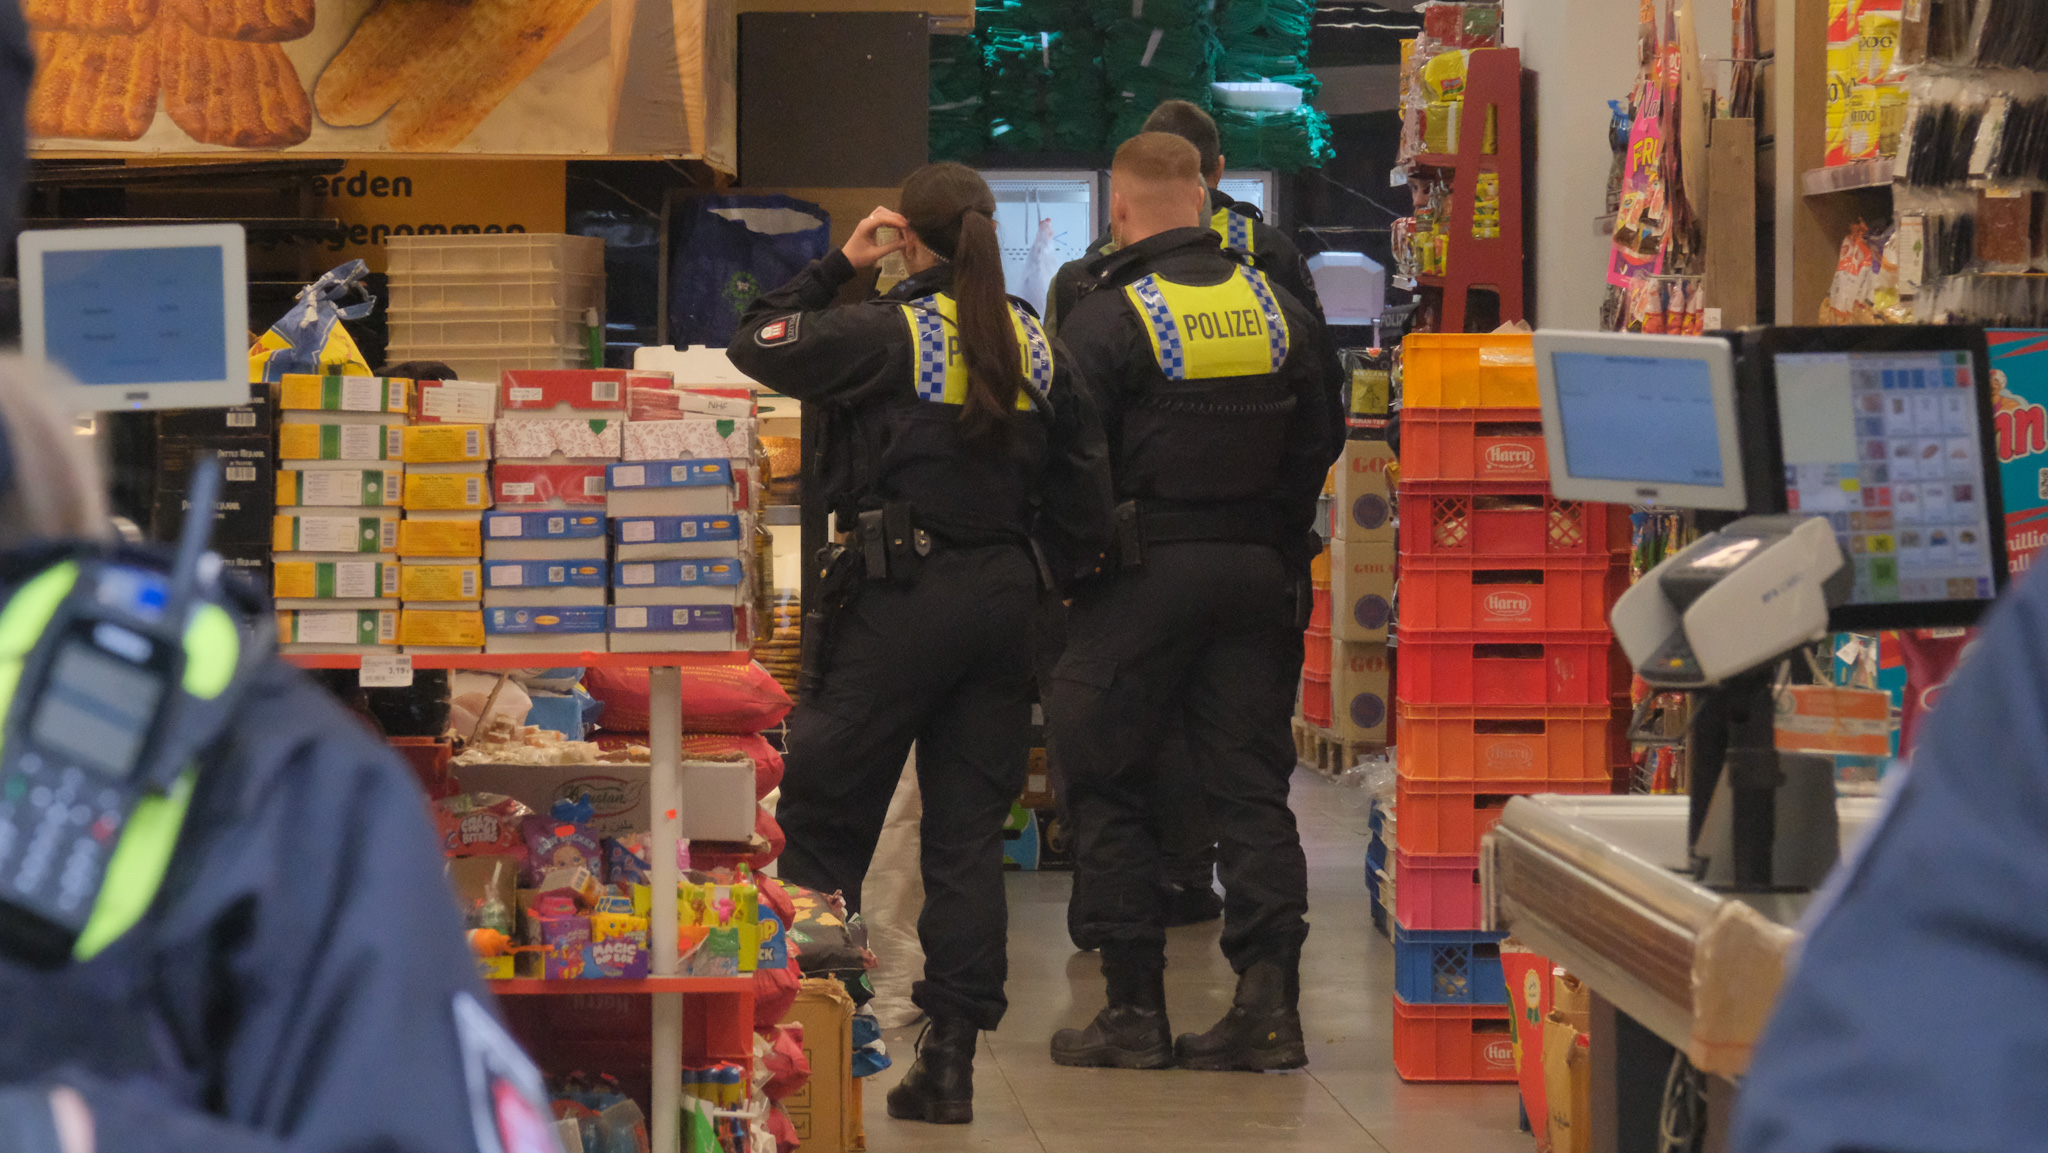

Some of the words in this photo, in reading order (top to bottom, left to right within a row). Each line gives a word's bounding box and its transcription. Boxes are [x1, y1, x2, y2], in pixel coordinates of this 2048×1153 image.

[312, 170, 412, 197] erden
[326, 222, 525, 251] genommen
[1182, 309, 1263, 341] POLIZEI
[1380, 313, 1416, 328] POLIZI
[1490, 447, 1530, 465] Harry
[1489, 595, 1527, 612] Harry
[592, 943, 637, 959] MAGIC
[1488, 1045, 1514, 1059] Har
